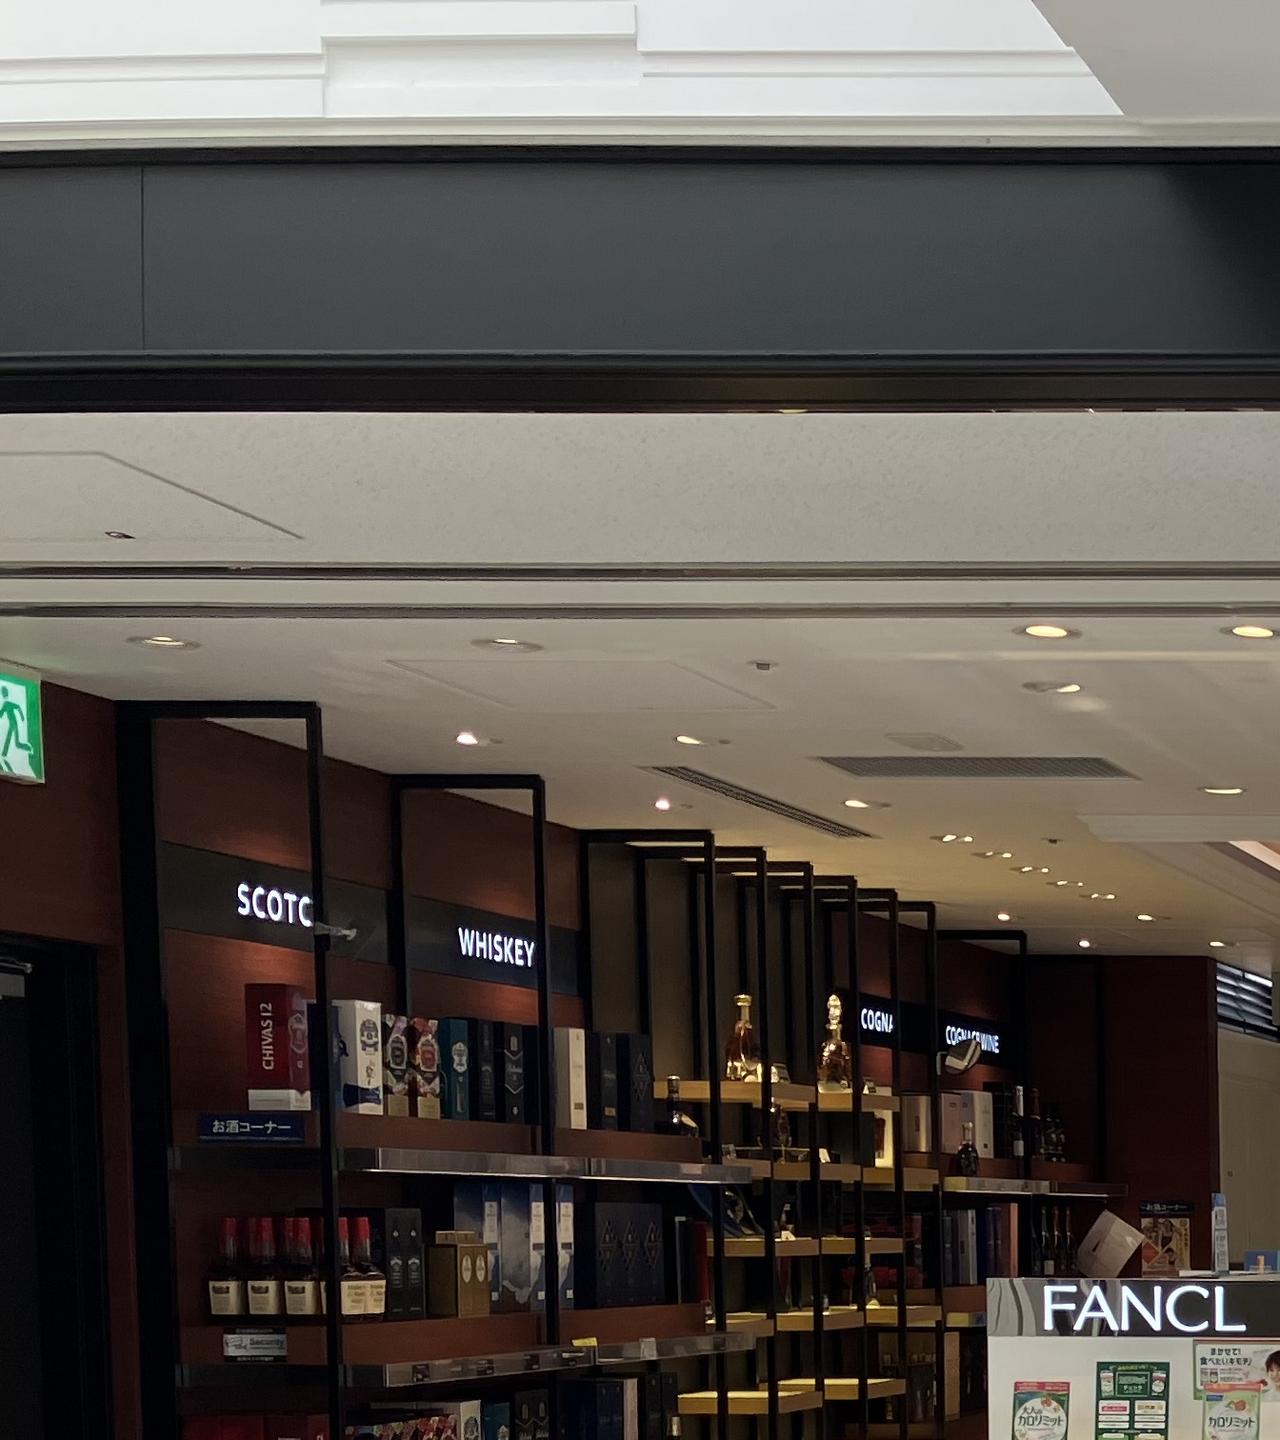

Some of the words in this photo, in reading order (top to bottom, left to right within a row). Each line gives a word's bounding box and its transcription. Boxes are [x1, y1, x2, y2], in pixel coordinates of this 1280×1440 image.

[237, 883, 312, 928] SCOTC
[457, 926, 536, 970] WHISKEY
[260, 1002, 272, 1016] 12
[260, 1021, 275, 1070] CHIVAS
[212, 1119, 291, 1134] お酒コーナー
[1043, 1285, 1246, 1332] FANCL
[1018, 1415, 1063, 1427] カロリミット
[1208, 1416, 1255, 1428] カロリミット
